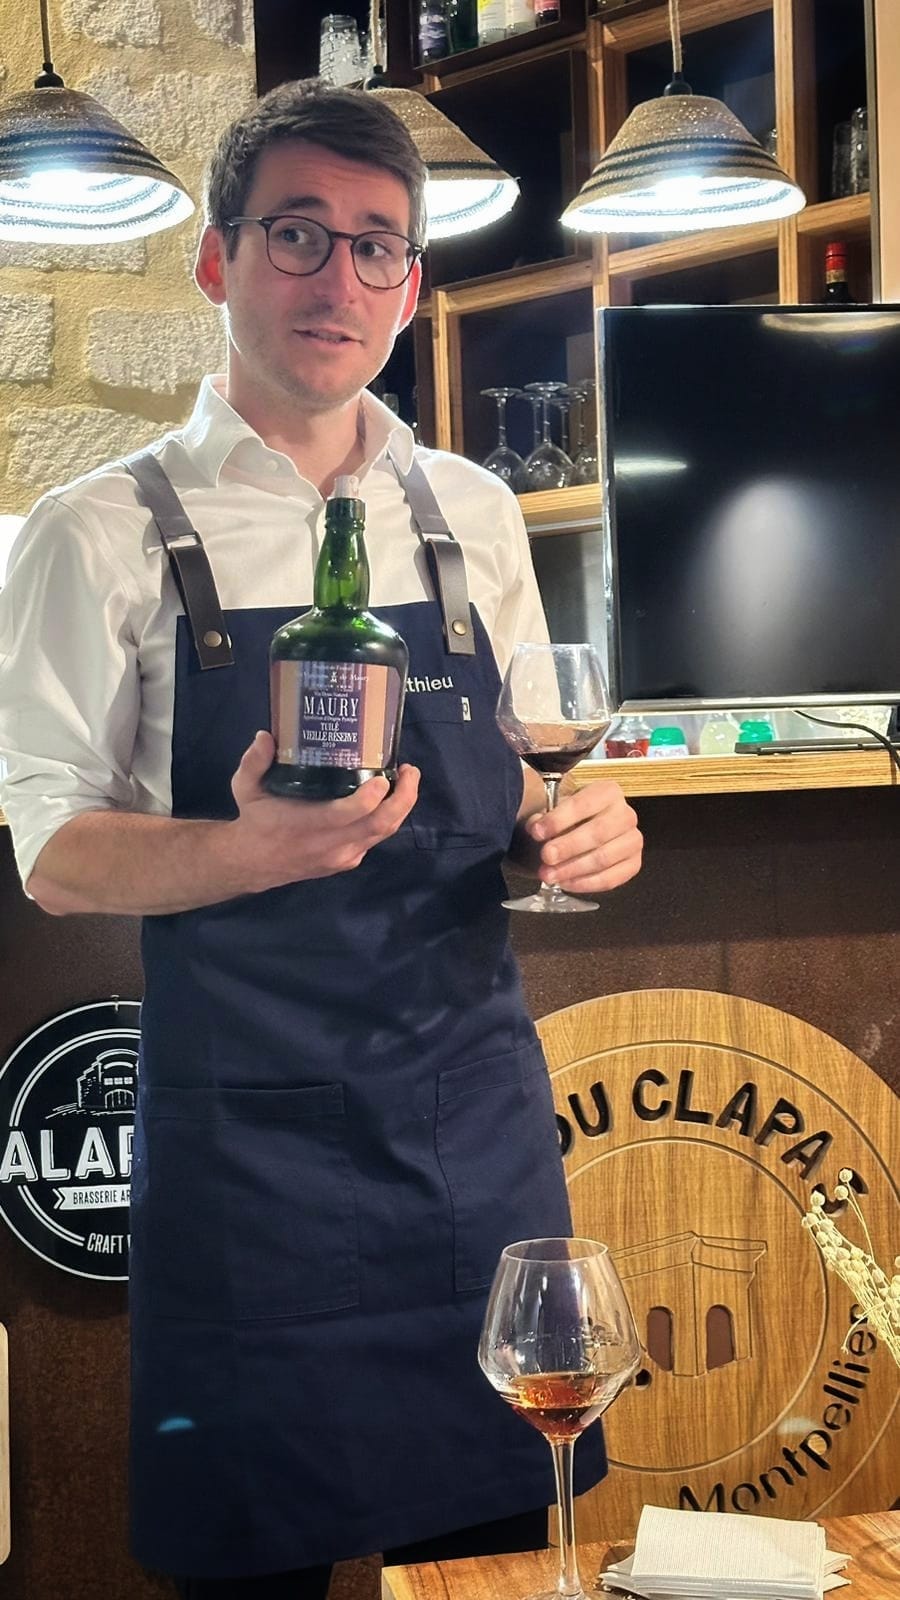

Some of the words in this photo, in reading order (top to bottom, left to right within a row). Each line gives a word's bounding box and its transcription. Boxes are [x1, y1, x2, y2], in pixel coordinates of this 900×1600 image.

[405, 676, 454, 692] thieu
[304, 696, 359, 717] MAURY
[320, 721, 340, 732] TUILÉ
[302, 730, 328, 741] VIEILLE
[328, 731, 358, 743] RÉSERVE
[73, 1191, 117, 1206] BRASSERIE
[87, 1233, 124, 1254] CRAFT
